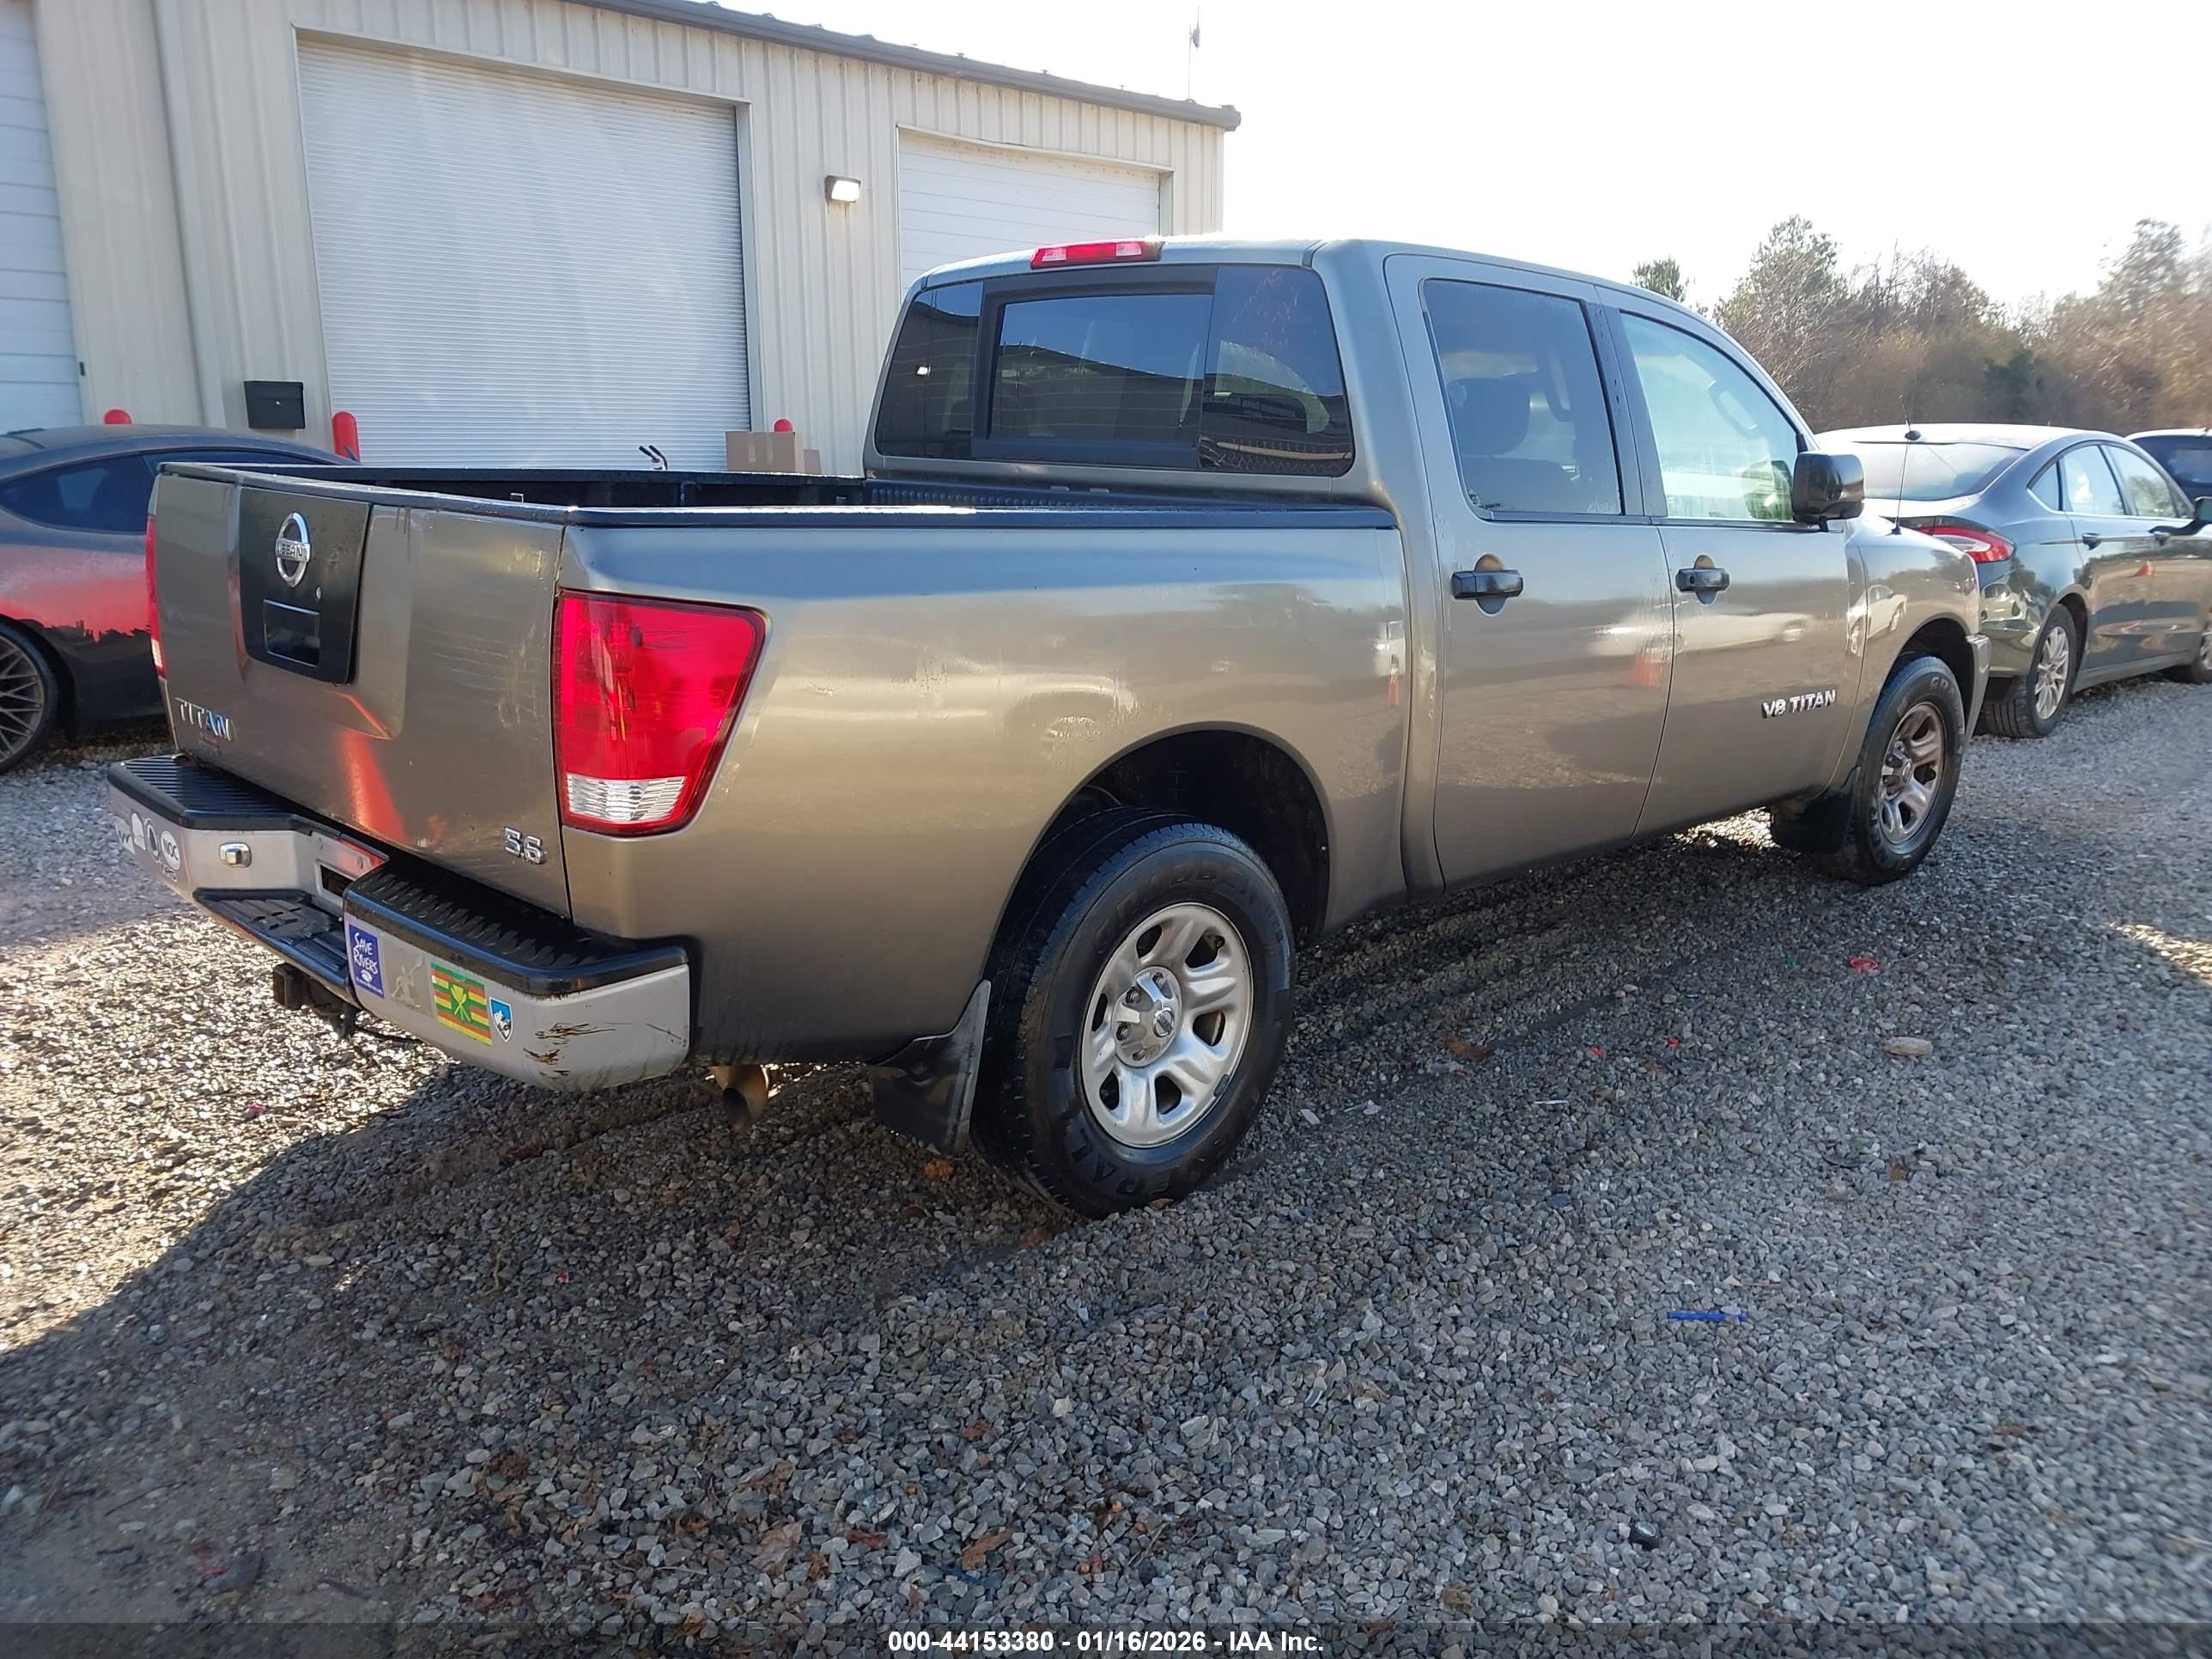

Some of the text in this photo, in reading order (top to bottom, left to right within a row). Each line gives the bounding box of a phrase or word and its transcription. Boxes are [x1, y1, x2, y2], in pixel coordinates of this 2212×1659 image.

[1763, 689, 1836, 716] V8 TITAN
[174, 696, 232, 743] TITAN
[162, 837, 179, 861] NOC
[505, 827, 542, 864] 5.6
[354, 932, 374, 956] SAVE
[353, 945, 379, 975] RIVERS
